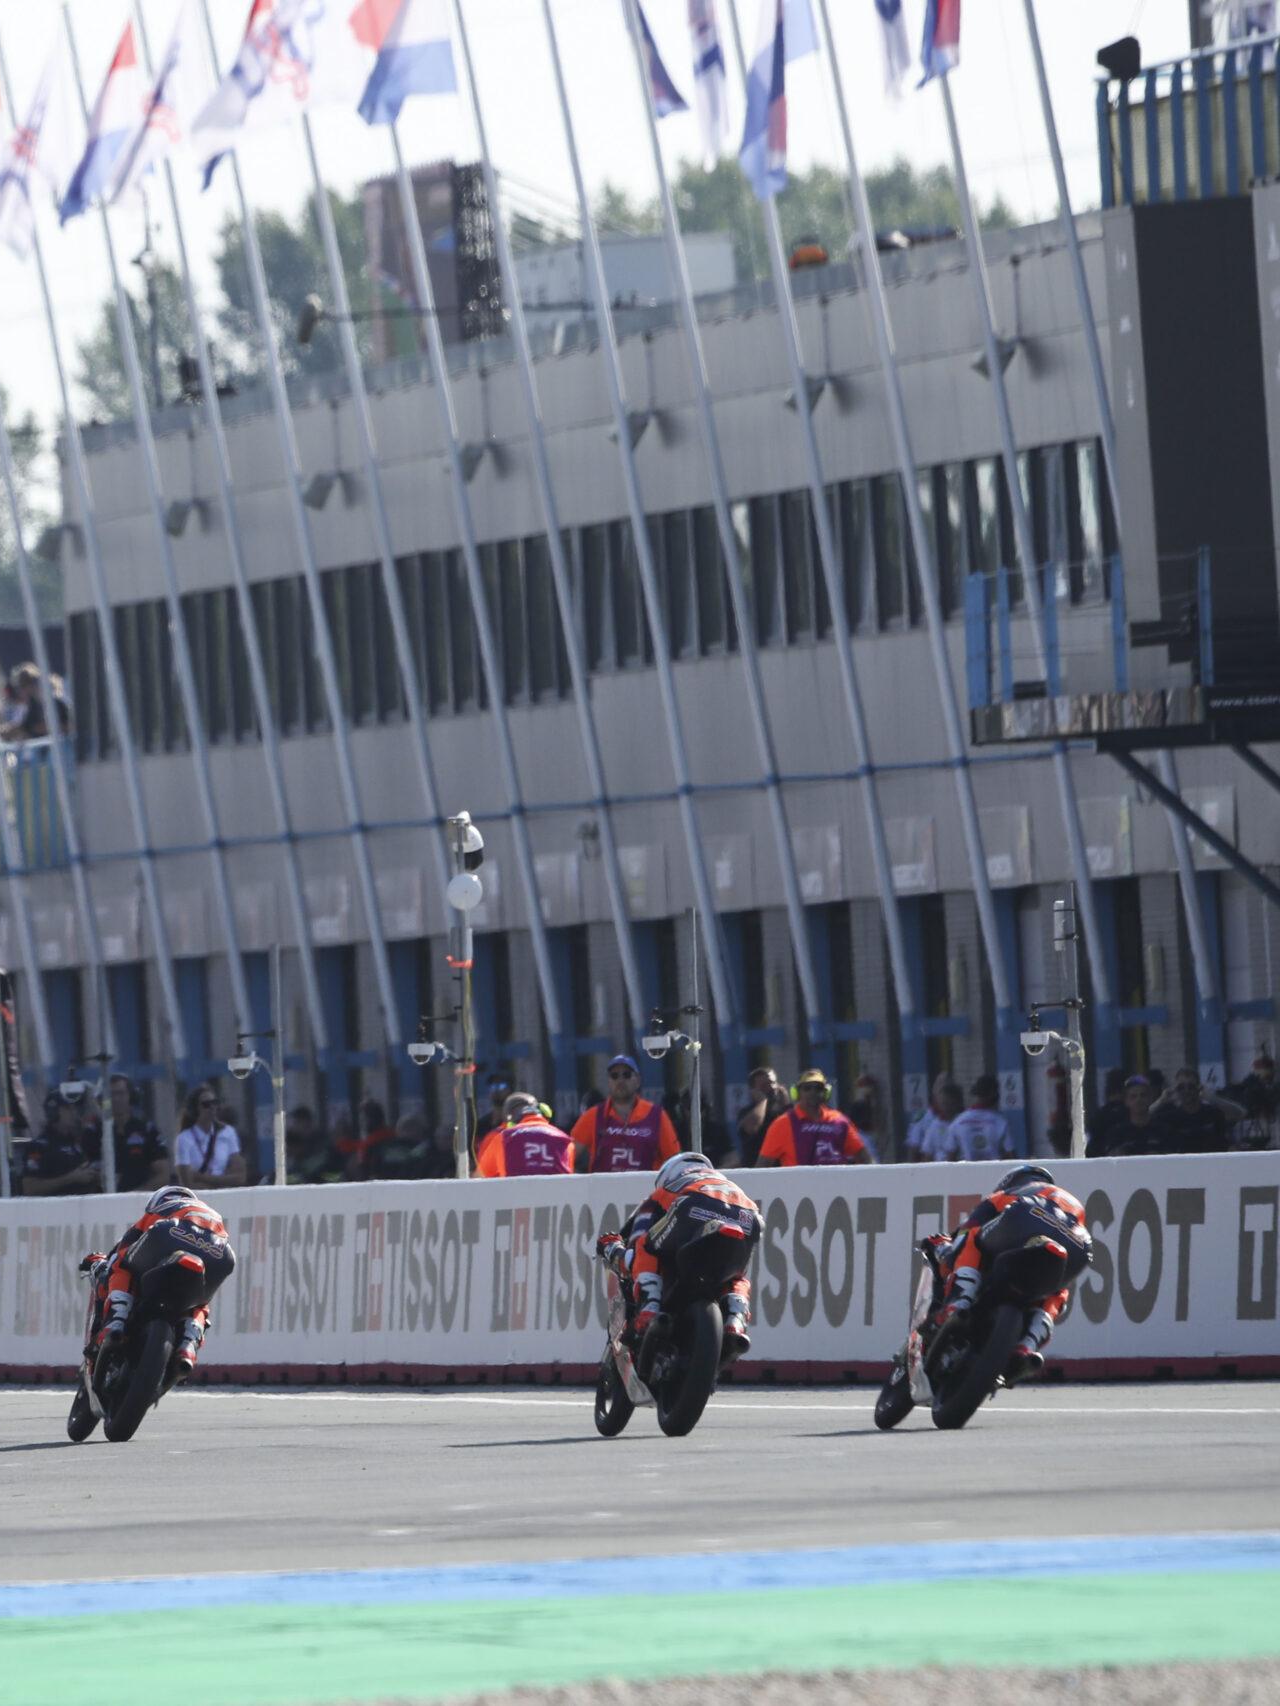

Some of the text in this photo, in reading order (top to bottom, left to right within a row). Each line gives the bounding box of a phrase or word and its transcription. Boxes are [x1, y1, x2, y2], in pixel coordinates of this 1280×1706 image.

[524, 1142, 555, 1161] PL
[611, 1147, 641, 1166] PL
[268, 1213, 345, 1334] TISSOT
[387, 1209, 481, 1333] TISSOT
